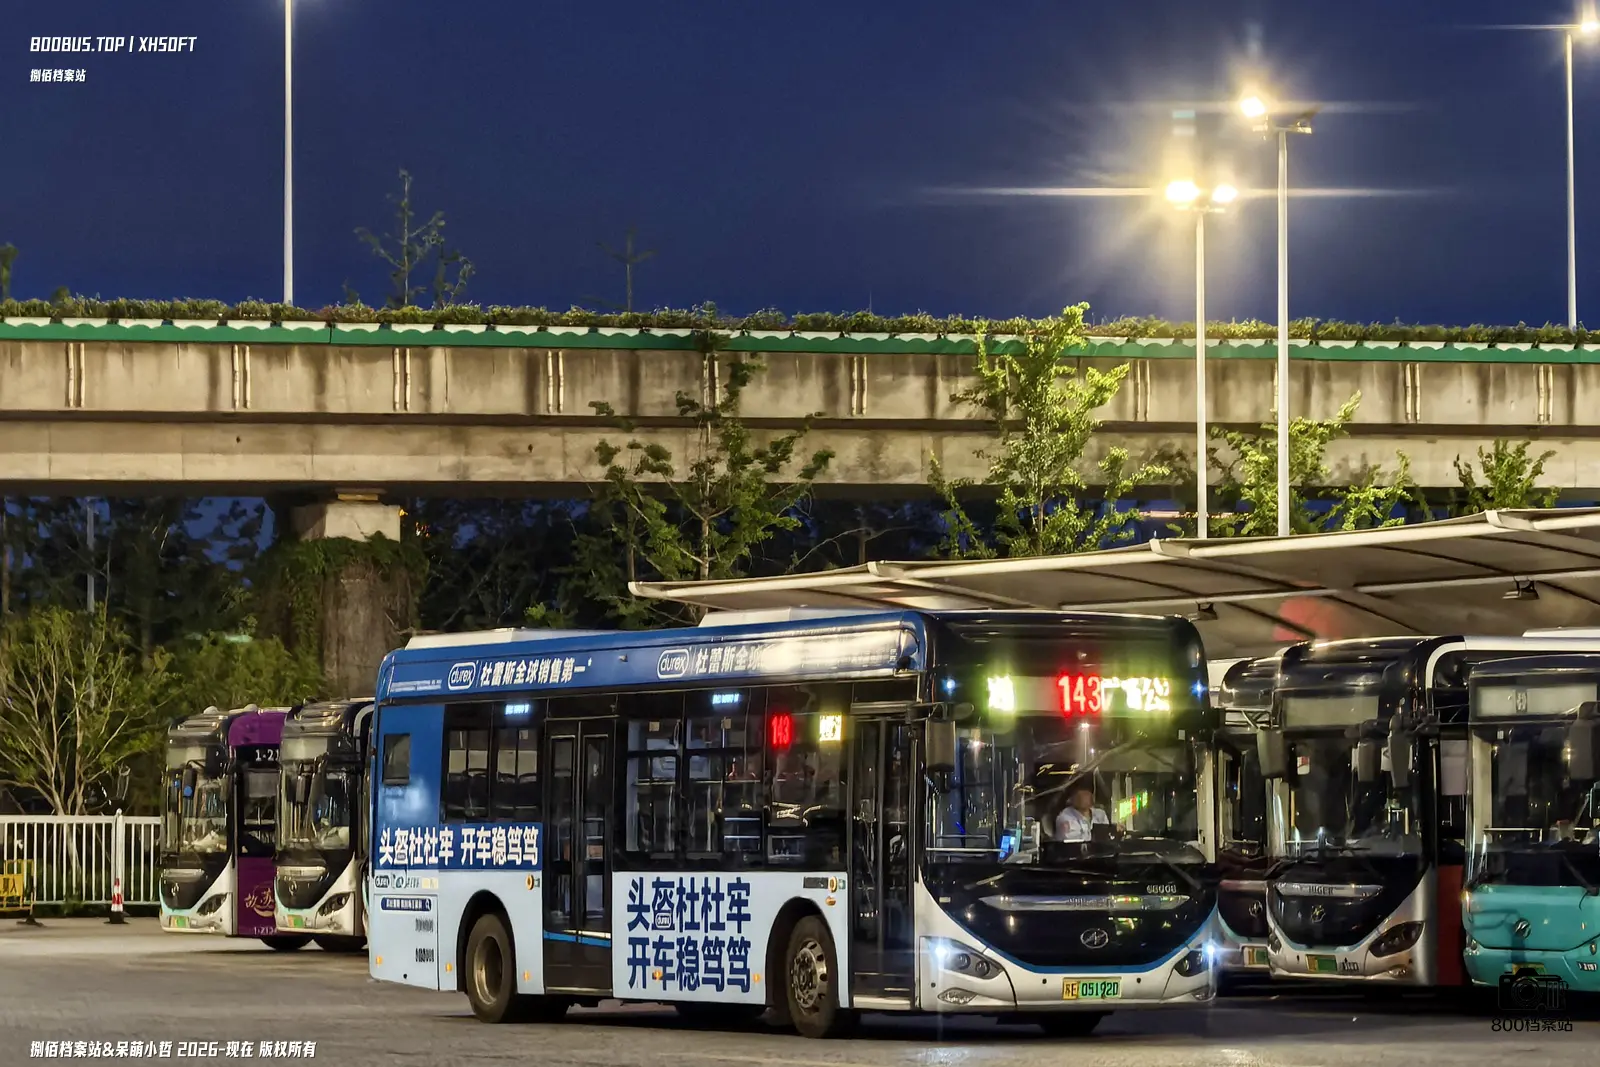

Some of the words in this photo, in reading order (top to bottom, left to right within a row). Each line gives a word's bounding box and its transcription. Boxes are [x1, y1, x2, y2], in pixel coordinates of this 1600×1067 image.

[450, 663, 475, 686] durex
[480, 657, 586, 687] 杜蕾斯全球销售第一
[660, 650, 687, 674] durex
[1058, 675, 1100, 712] 143
[379, 826, 454, 866] 头盔杜杜牢
[460, 825, 539, 866] 开车稳笃笃
[627, 876, 751, 934] 头盔杜杜牢
[627, 935, 751, 993] 开车稳笃笃
